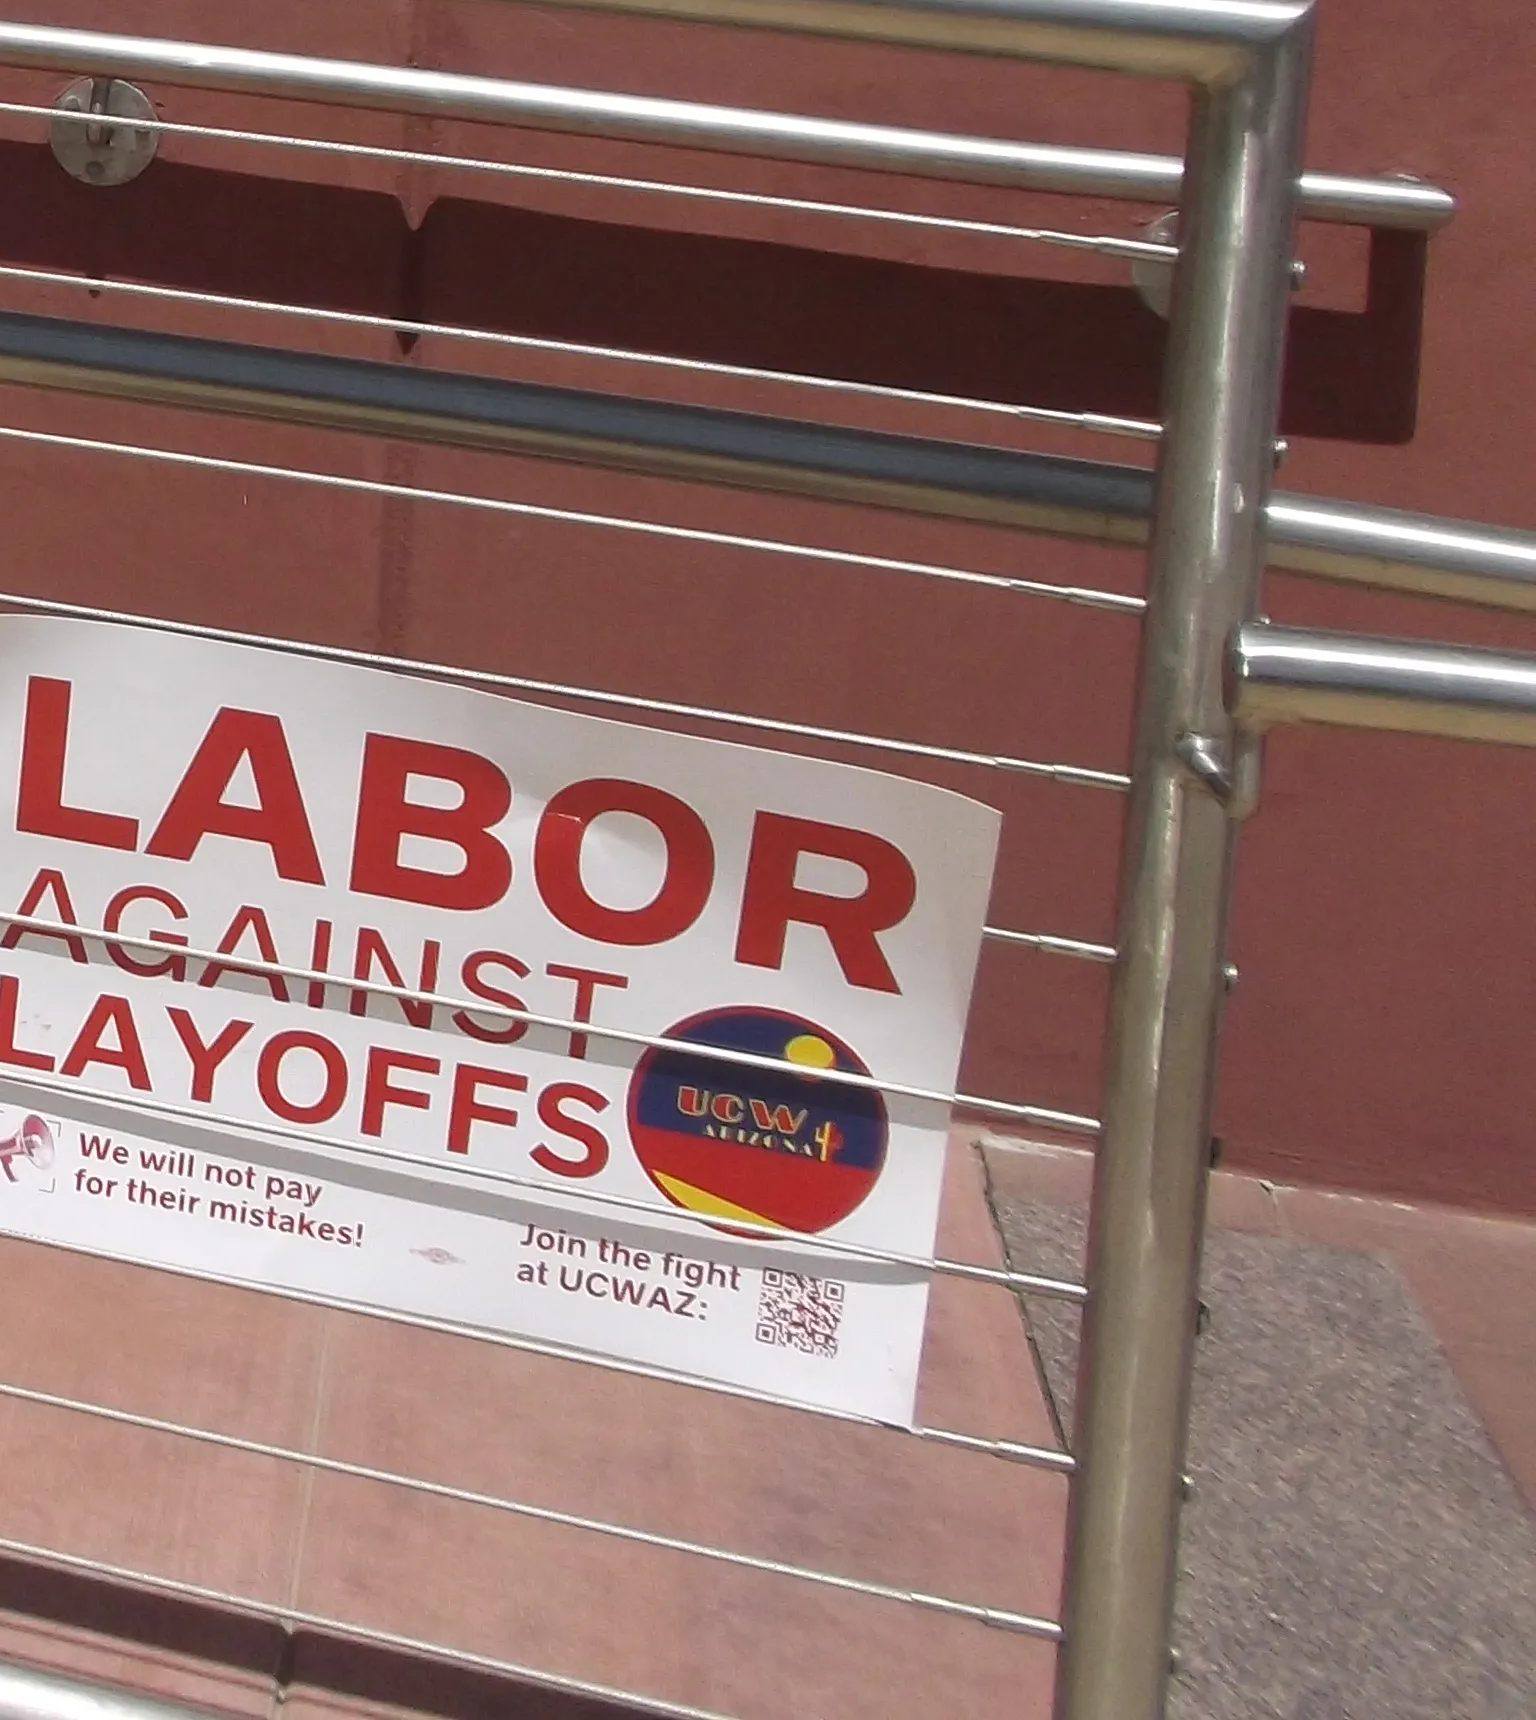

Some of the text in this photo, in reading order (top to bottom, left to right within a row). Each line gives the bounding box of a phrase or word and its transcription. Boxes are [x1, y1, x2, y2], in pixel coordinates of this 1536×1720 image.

[12, 674, 919, 997] LABOR
[676, 1085, 809, 1134] UCW
[79, 1132, 324, 1208] We will not pay
[74, 1168, 365, 1248] for their mistakes!
[515, 1261, 709, 1321] at UCWAZ:
[520, 1222, 742, 1292] Join the fight
